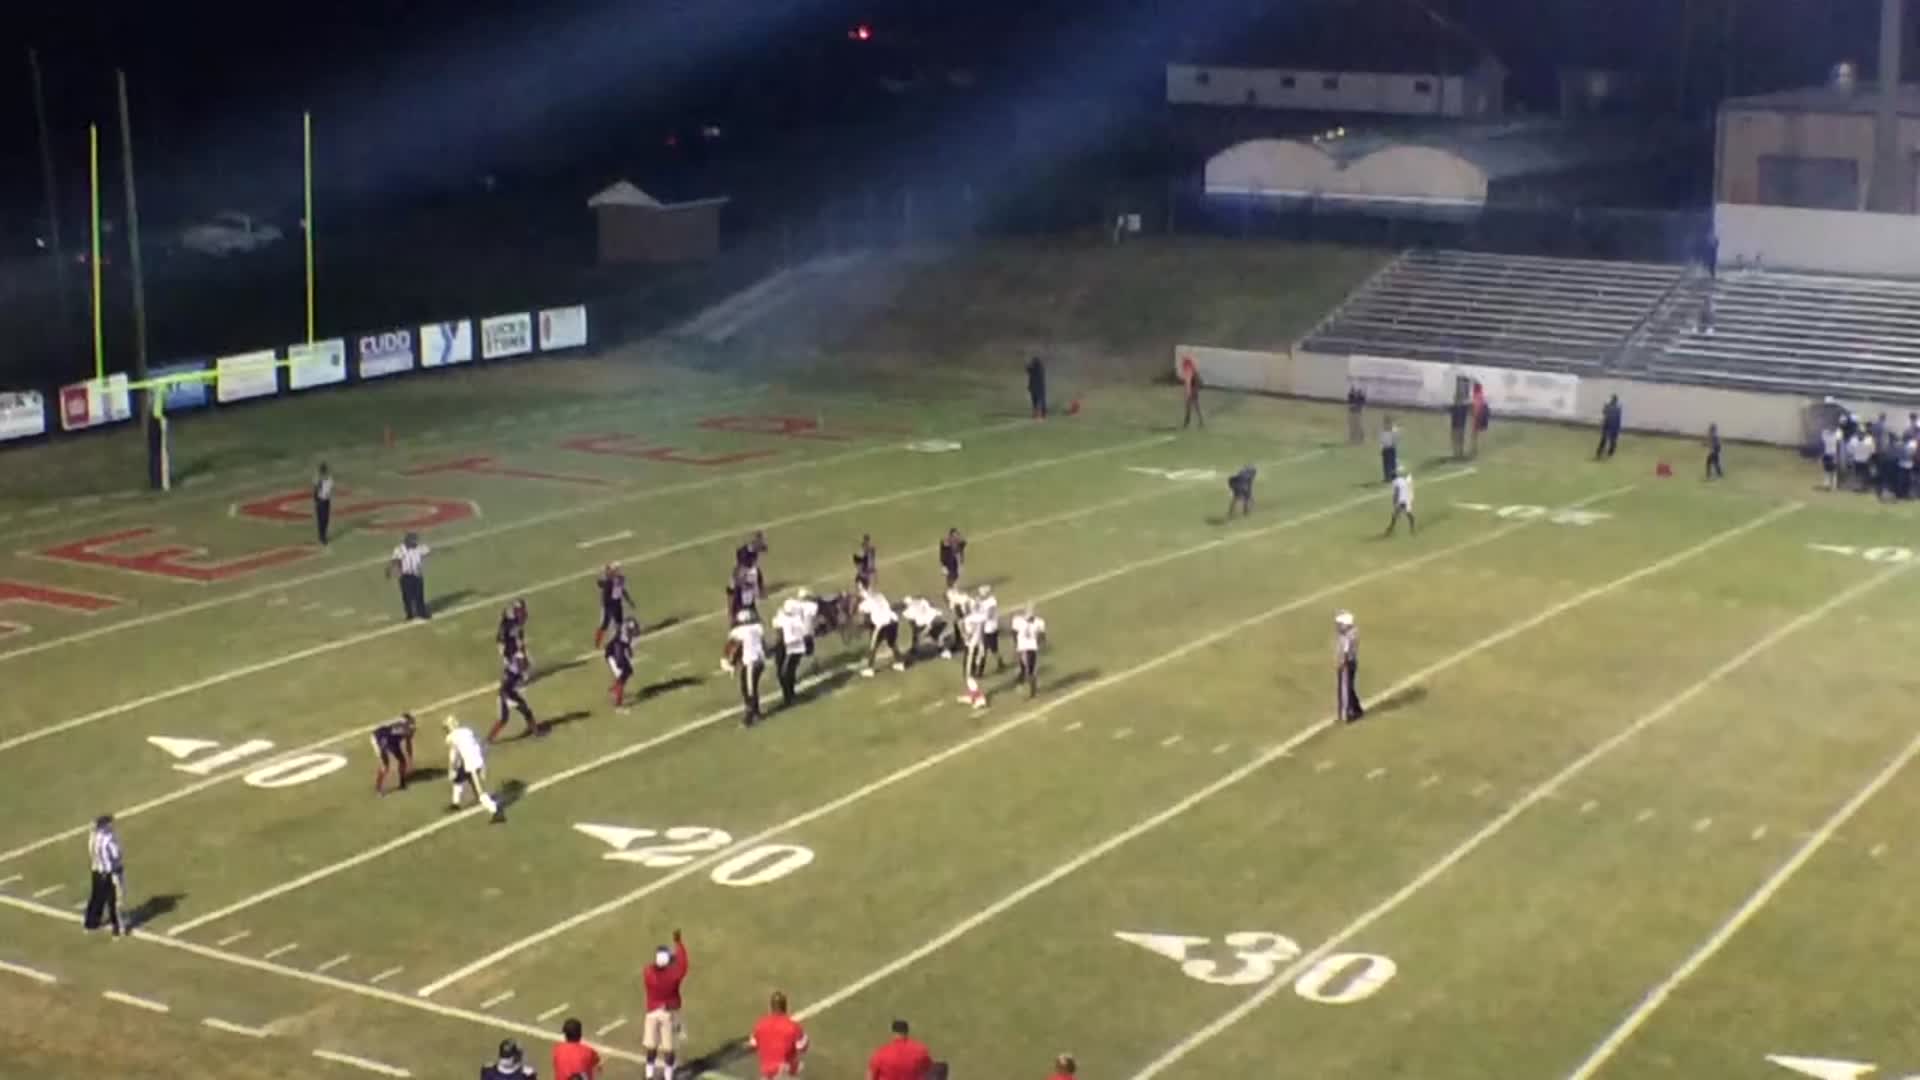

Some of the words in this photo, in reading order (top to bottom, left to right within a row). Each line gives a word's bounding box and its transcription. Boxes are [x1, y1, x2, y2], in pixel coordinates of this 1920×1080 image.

[172, 738, 349, 788] 10
[602, 826, 815, 887] 20
[1181, 930, 1397, 1004] 30
